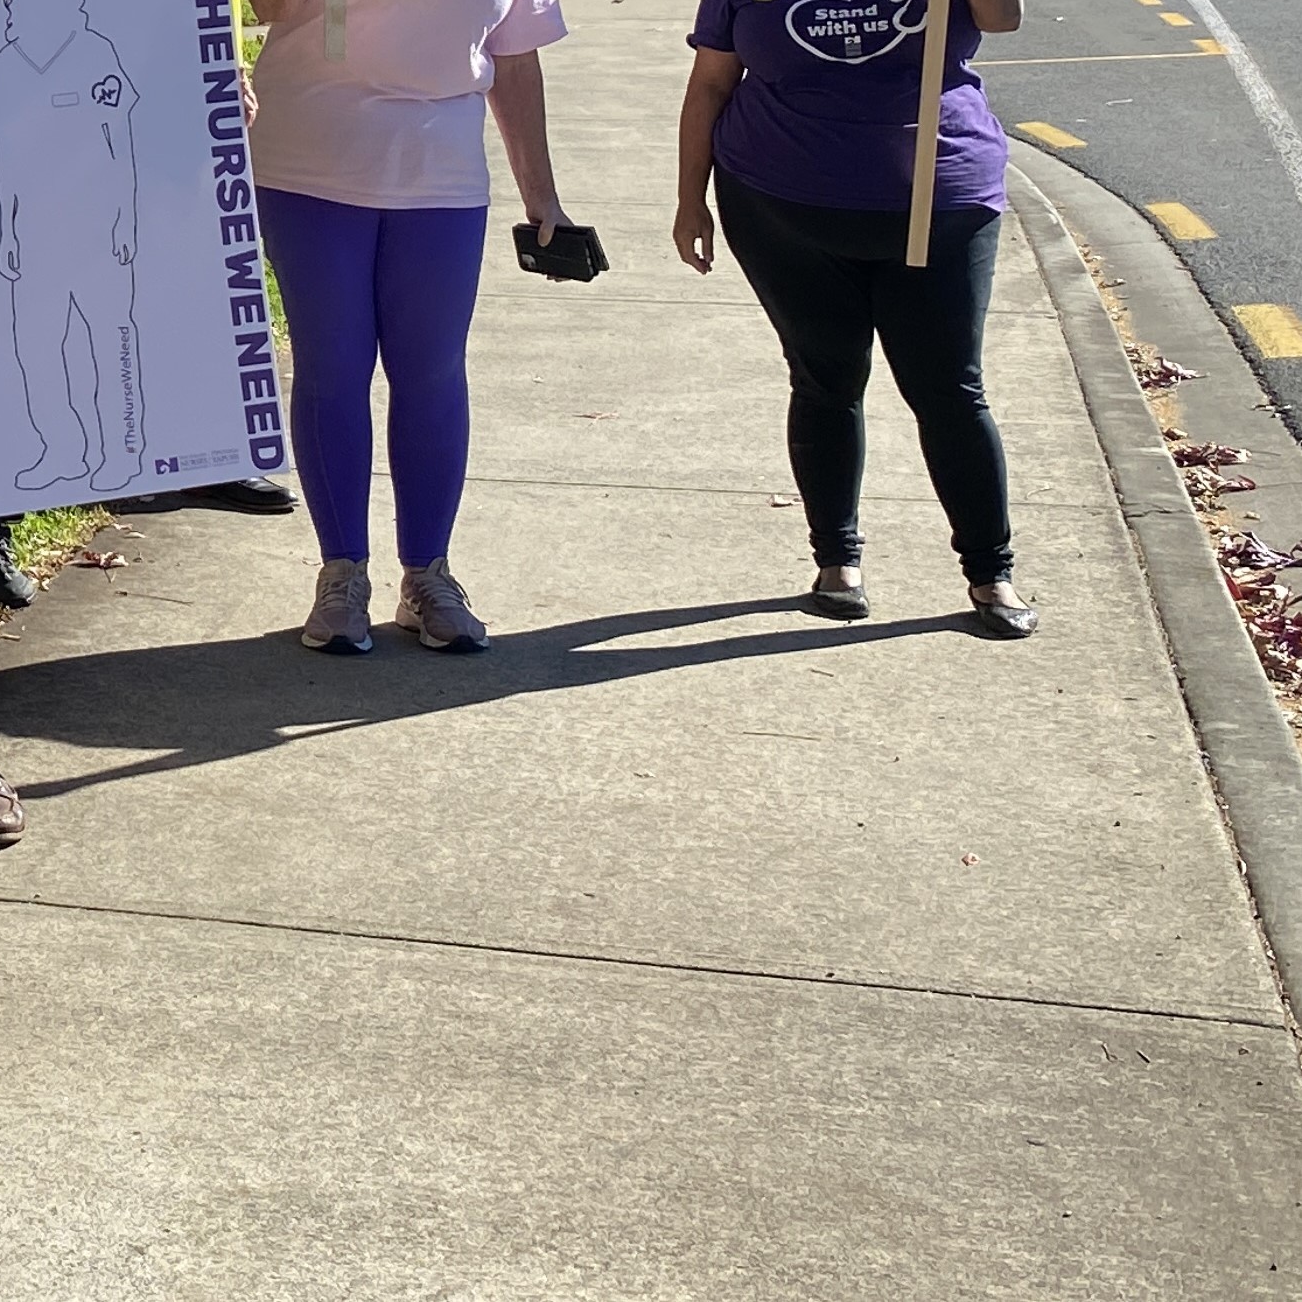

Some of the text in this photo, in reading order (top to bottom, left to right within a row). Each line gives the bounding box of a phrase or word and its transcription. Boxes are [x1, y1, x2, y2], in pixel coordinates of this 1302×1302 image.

[815, 4, 878, 20] Stand
[807, 20, 889, 37] with us
[118, 326, 137, 454] #TheNurseWeNeed
